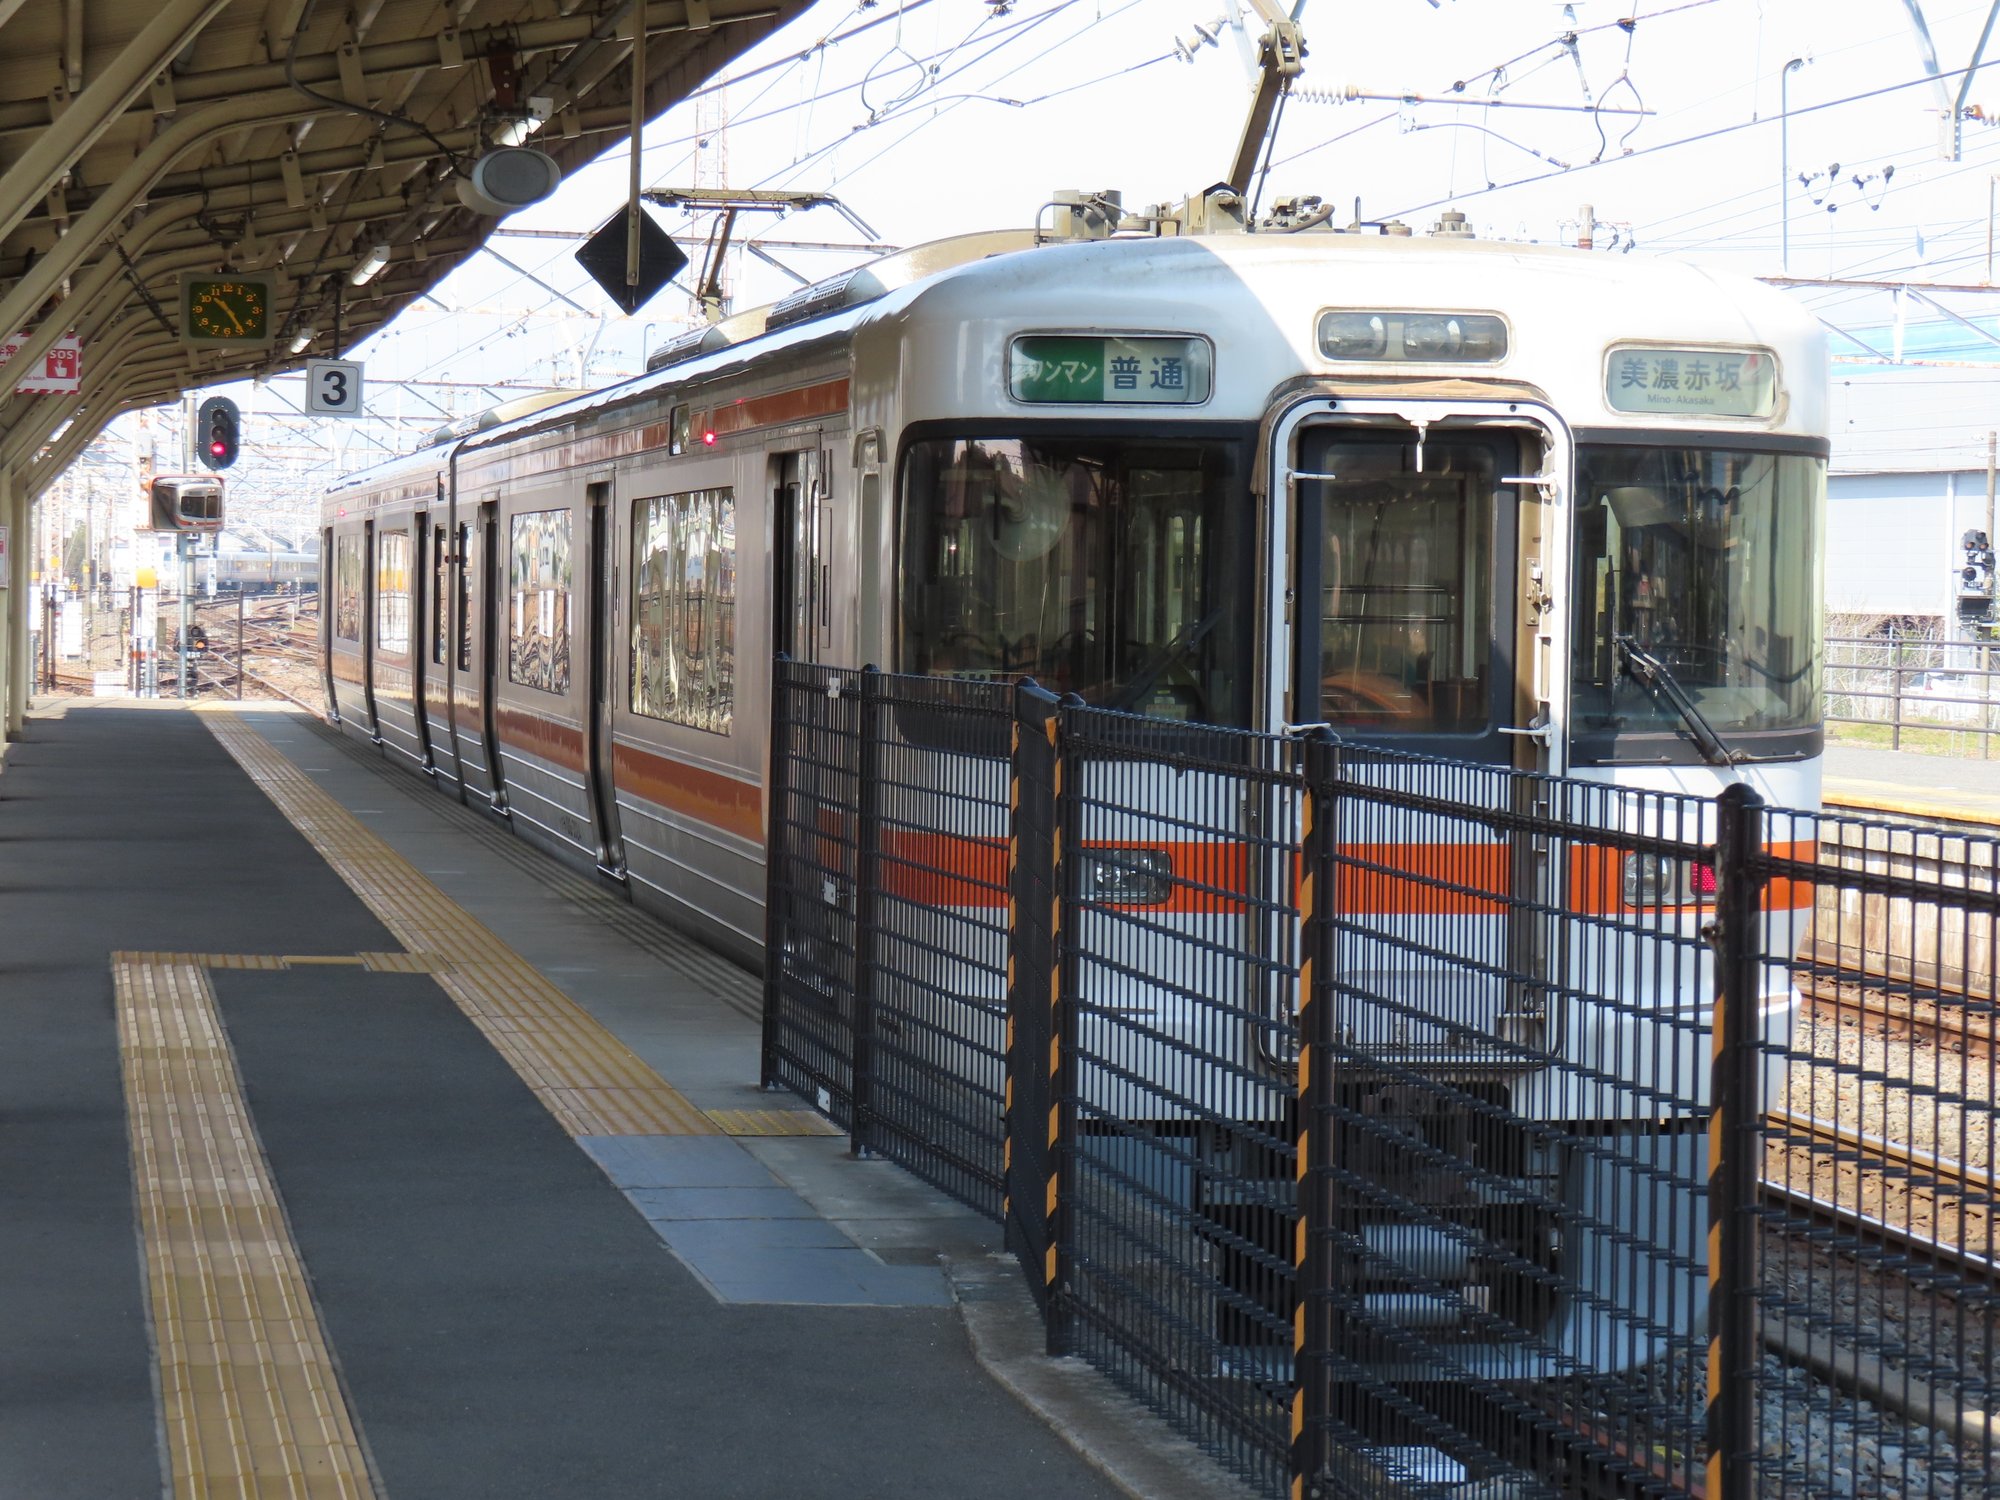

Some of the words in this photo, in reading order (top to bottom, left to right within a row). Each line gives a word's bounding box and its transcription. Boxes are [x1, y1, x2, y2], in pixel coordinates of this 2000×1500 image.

[211, 288, 221, 296] 11
[222, 284, 233, 293] 12
[201, 295, 212, 303] 10
[246, 294, 254, 303] 2
[195, 305, 203, 314] 9
[252, 306, 260, 315] 3
[201, 317, 209, 326] 8
[245, 318, 254, 327] 4
[212, 324, 220, 333] 7
[223, 327, 231, 335] 6
[49, 350, 74, 360] SOS
[1109, 355, 1184, 391] 普通
[1620, 357, 1742, 392] 美濃赤坂
[321, 370, 348, 406] 3
[1647, 393, 1715, 406] Mino-Akasaka
